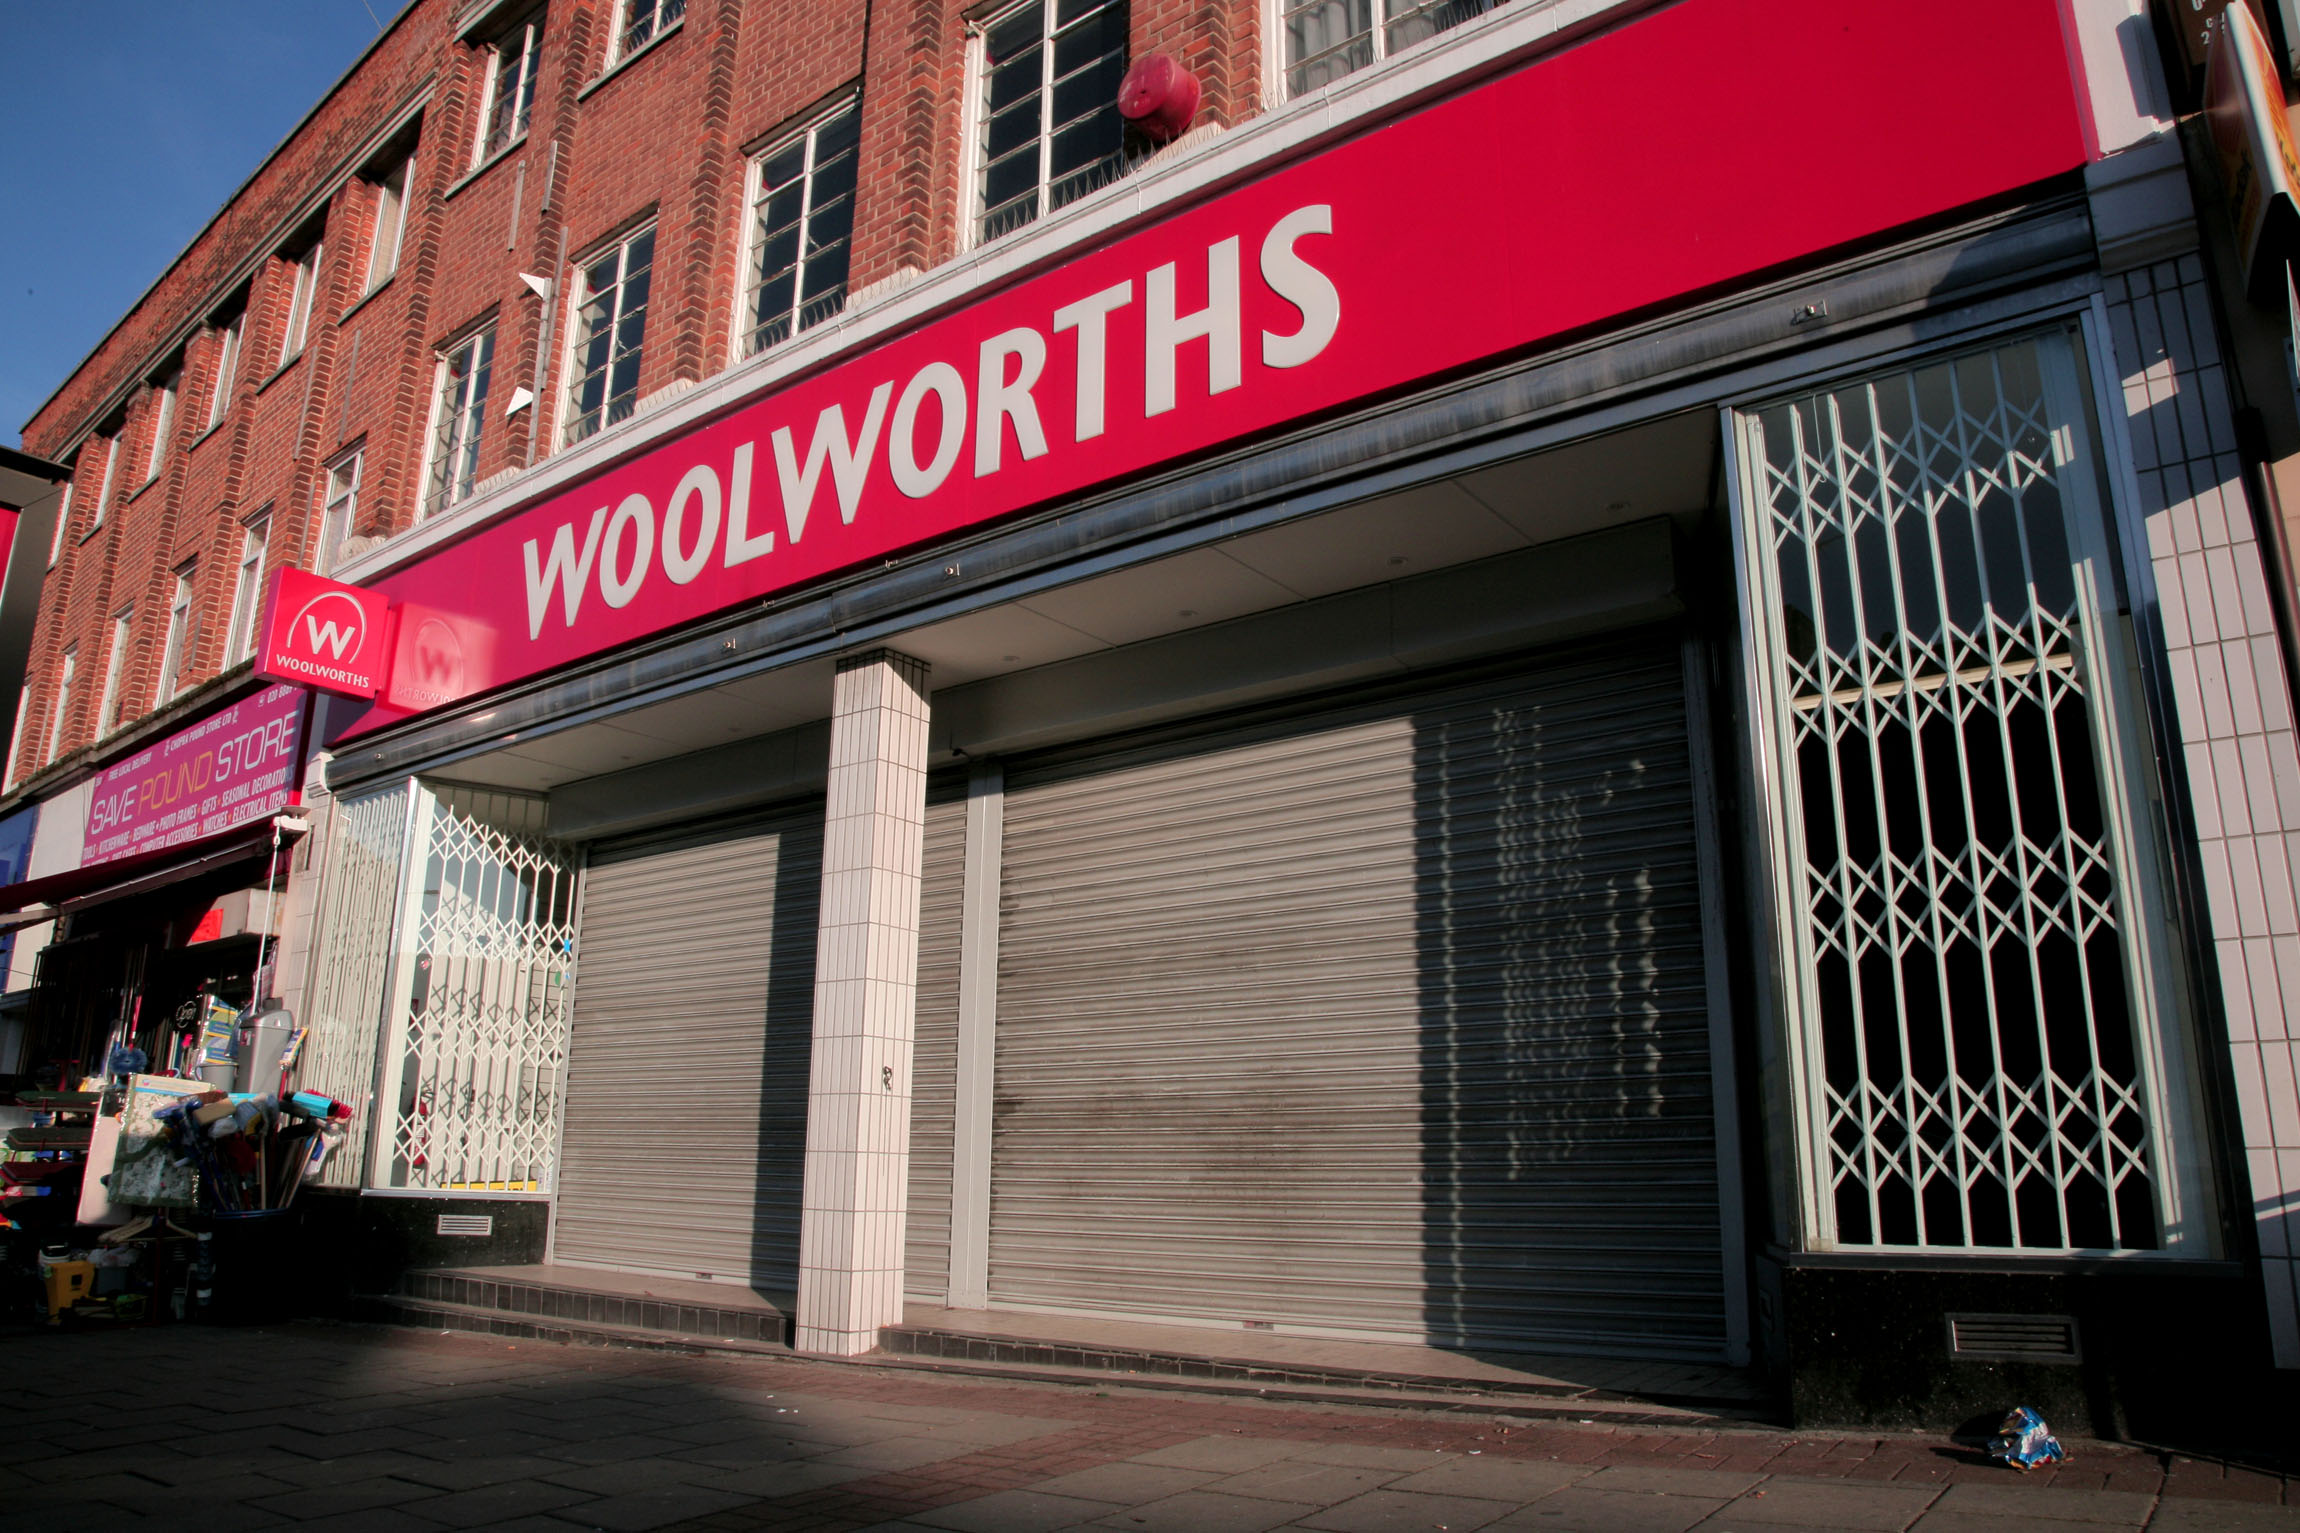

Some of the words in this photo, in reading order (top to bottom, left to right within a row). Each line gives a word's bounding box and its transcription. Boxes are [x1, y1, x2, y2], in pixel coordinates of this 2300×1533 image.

[523, 204, 1341, 641] WOOLWORTHS
[306, 614, 356, 661] W
[275, 654, 370, 688] WOOLWORTHS
[189, 725, 206, 743] POUND
[206, 717, 222, 734] STORE
[222, 712, 232, 726] LTD
[91, 785, 137, 835] SAVE
[138, 750, 213, 816] POUND
[215, 710, 299, 782] STORE
[108, 768, 119, 781] FREE
[119, 762, 131, 777] LOCAL
[131, 752, 152, 770] DELIVERY
[99, 830, 130, 854] KITCHENWARE
[159, 812, 176, 832] PHOTO
[176, 803, 198, 825] FRAMES
[202, 795, 218, 815] GIFTS
[222, 782, 250, 807] SEASONAL
[252, 764, 295, 795] DECORATIONS
[140, 835, 165, 854] COMPUTER
[165, 822, 199, 847] ACCESSORIES
[203, 810, 228, 833] WATCHES
[232, 795, 267, 823] ELECTRICAL
[268, 787, 288, 809] ITEMS
